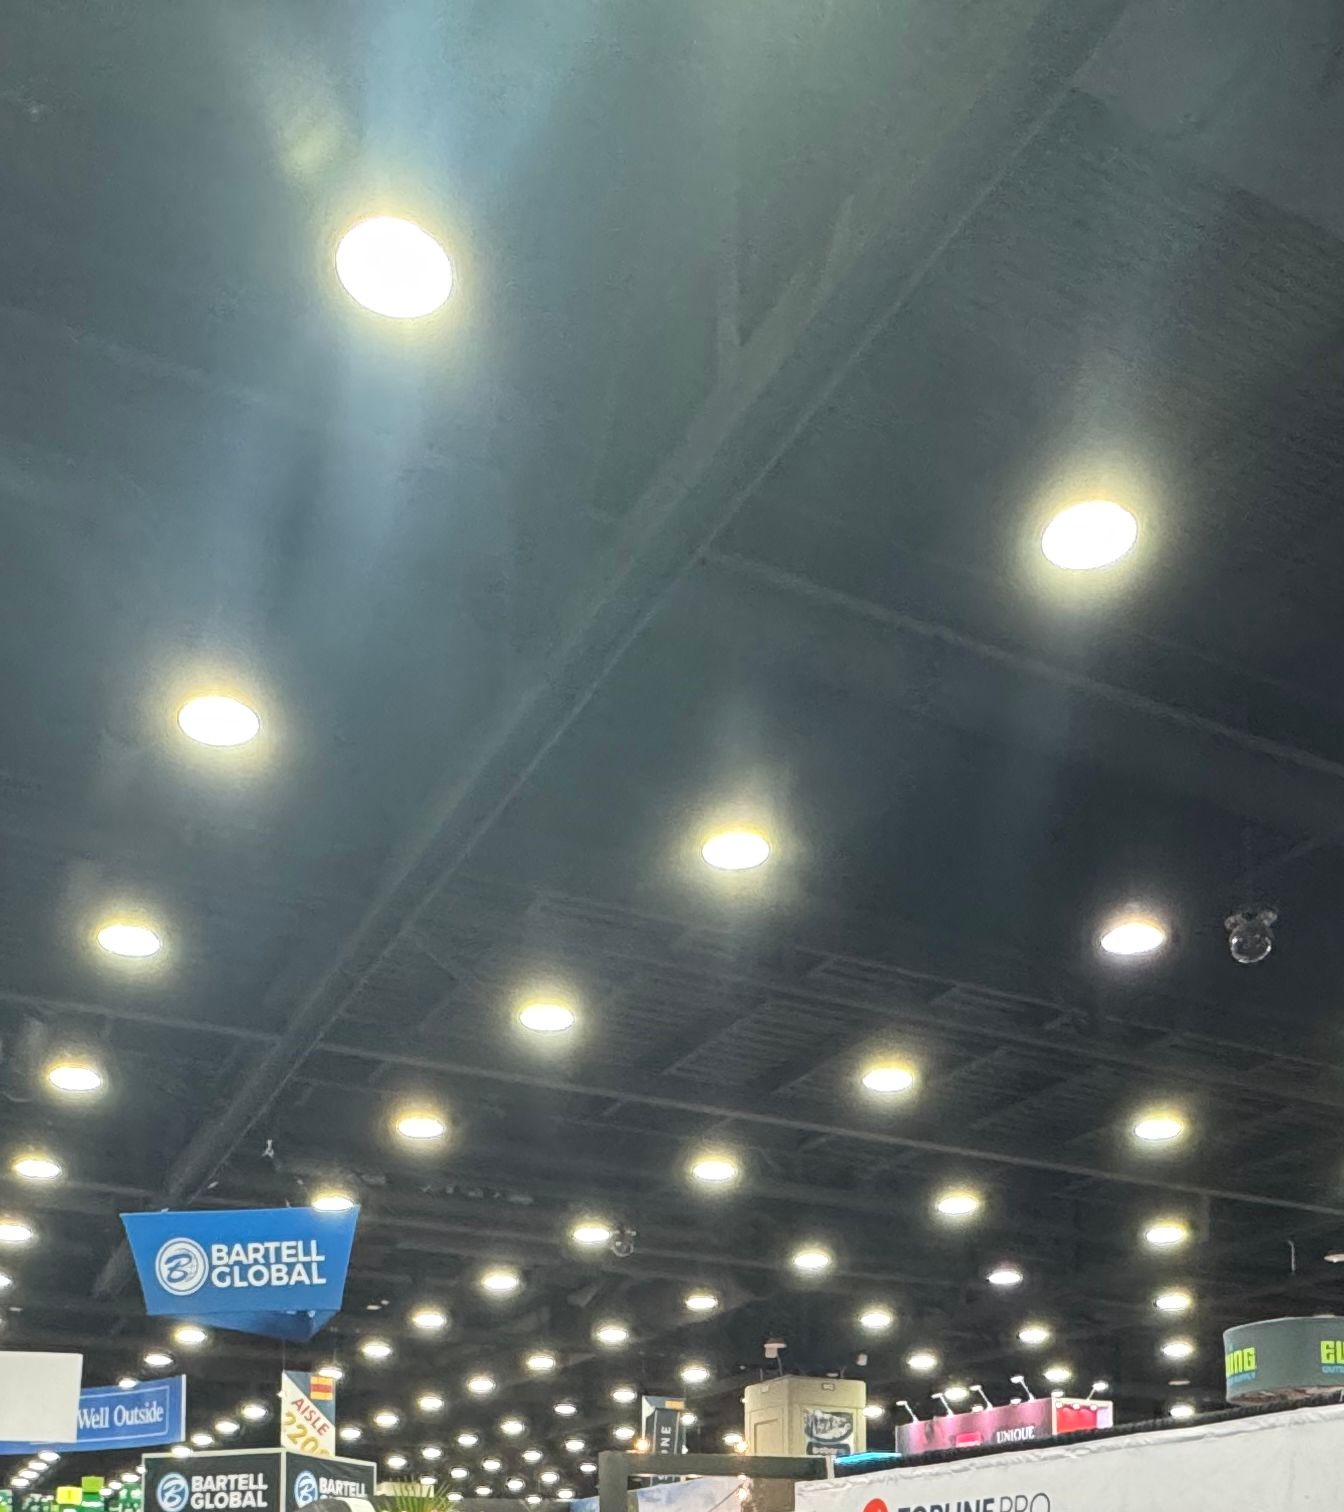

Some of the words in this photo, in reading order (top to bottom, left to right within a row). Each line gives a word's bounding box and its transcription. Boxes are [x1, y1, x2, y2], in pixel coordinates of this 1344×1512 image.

[211, 1240, 326, 1265] BARTELL
[211, 1263, 327, 1288] GLOBAL
[77, 1406, 110, 1429] Well
[113, 1400, 165, 1427] Outside
[291, 1398, 330, 1436] AISLE
[996, 1425, 1035, 1444] UNIQUE
[191, 1473, 268, 1492] BARTELL
[318, 1477, 368, 1497] BARTELL
[190, 1490, 268, 1509] GLOBAL
